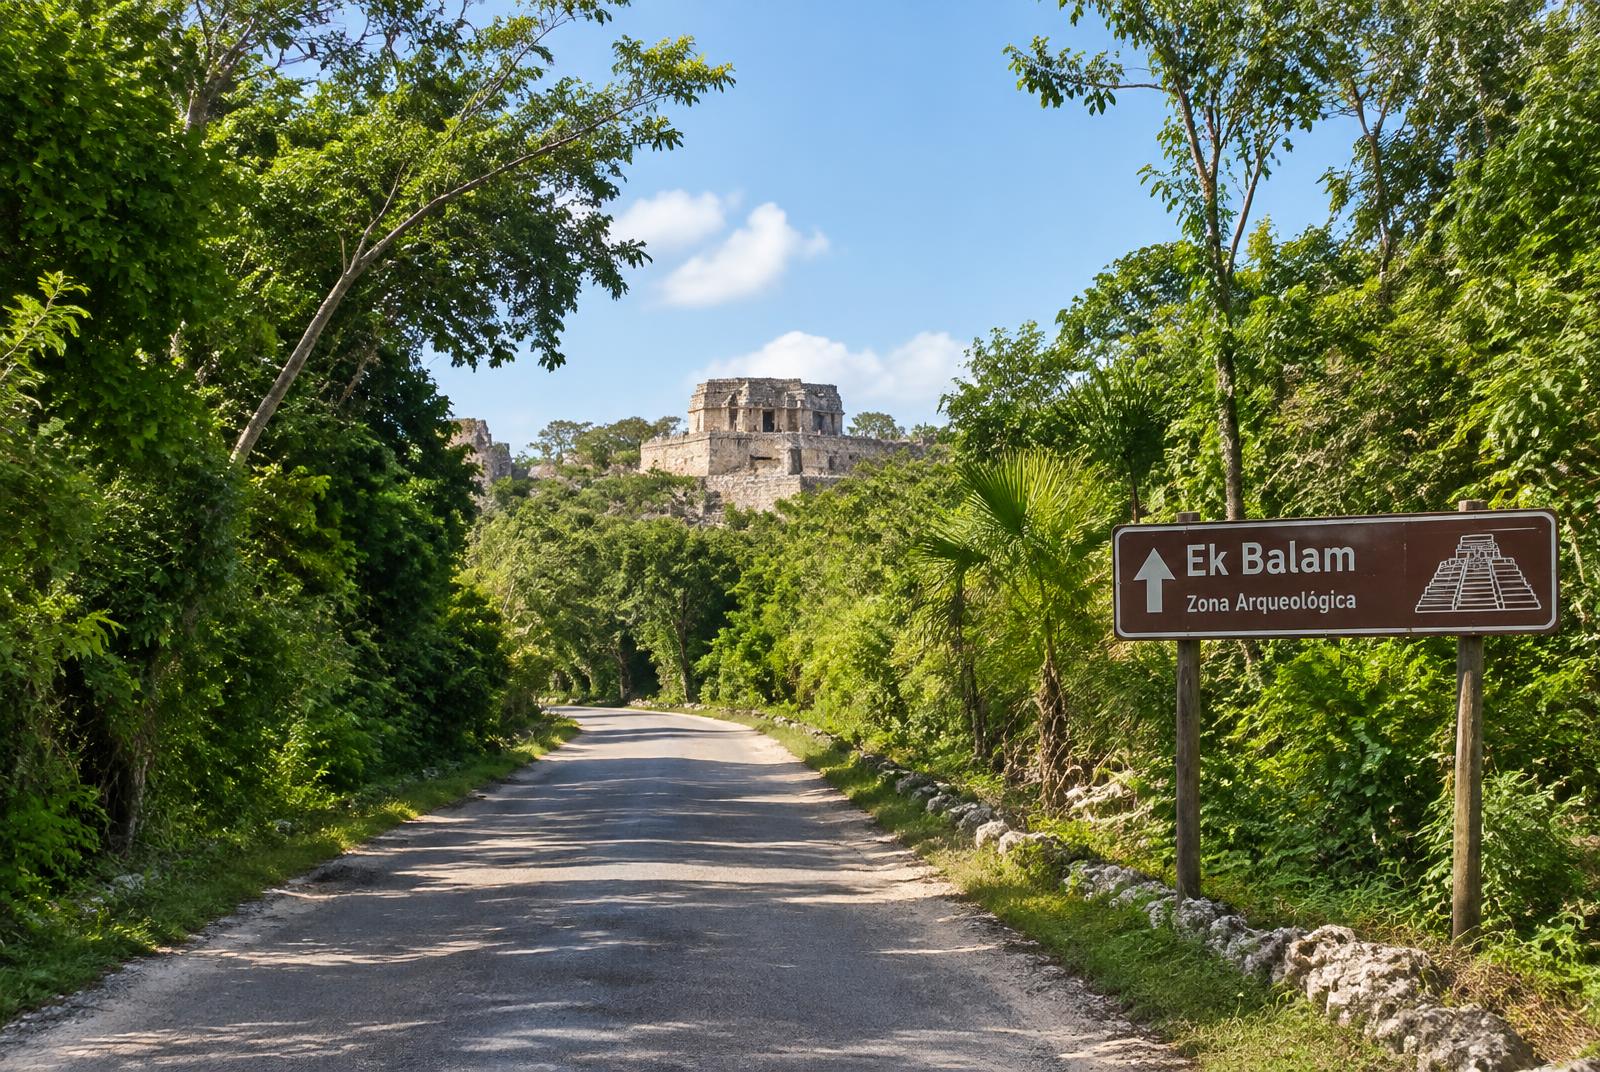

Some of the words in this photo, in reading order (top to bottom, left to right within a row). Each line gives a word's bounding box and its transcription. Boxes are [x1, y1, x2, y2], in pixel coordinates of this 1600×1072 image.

[1187, 543, 1229, 577] Ek
[1242, 540, 1355, 575] Balam
[1186, 594, 1230, 613] Zona
[1235, 589, 1356, 615] Arqueológica
